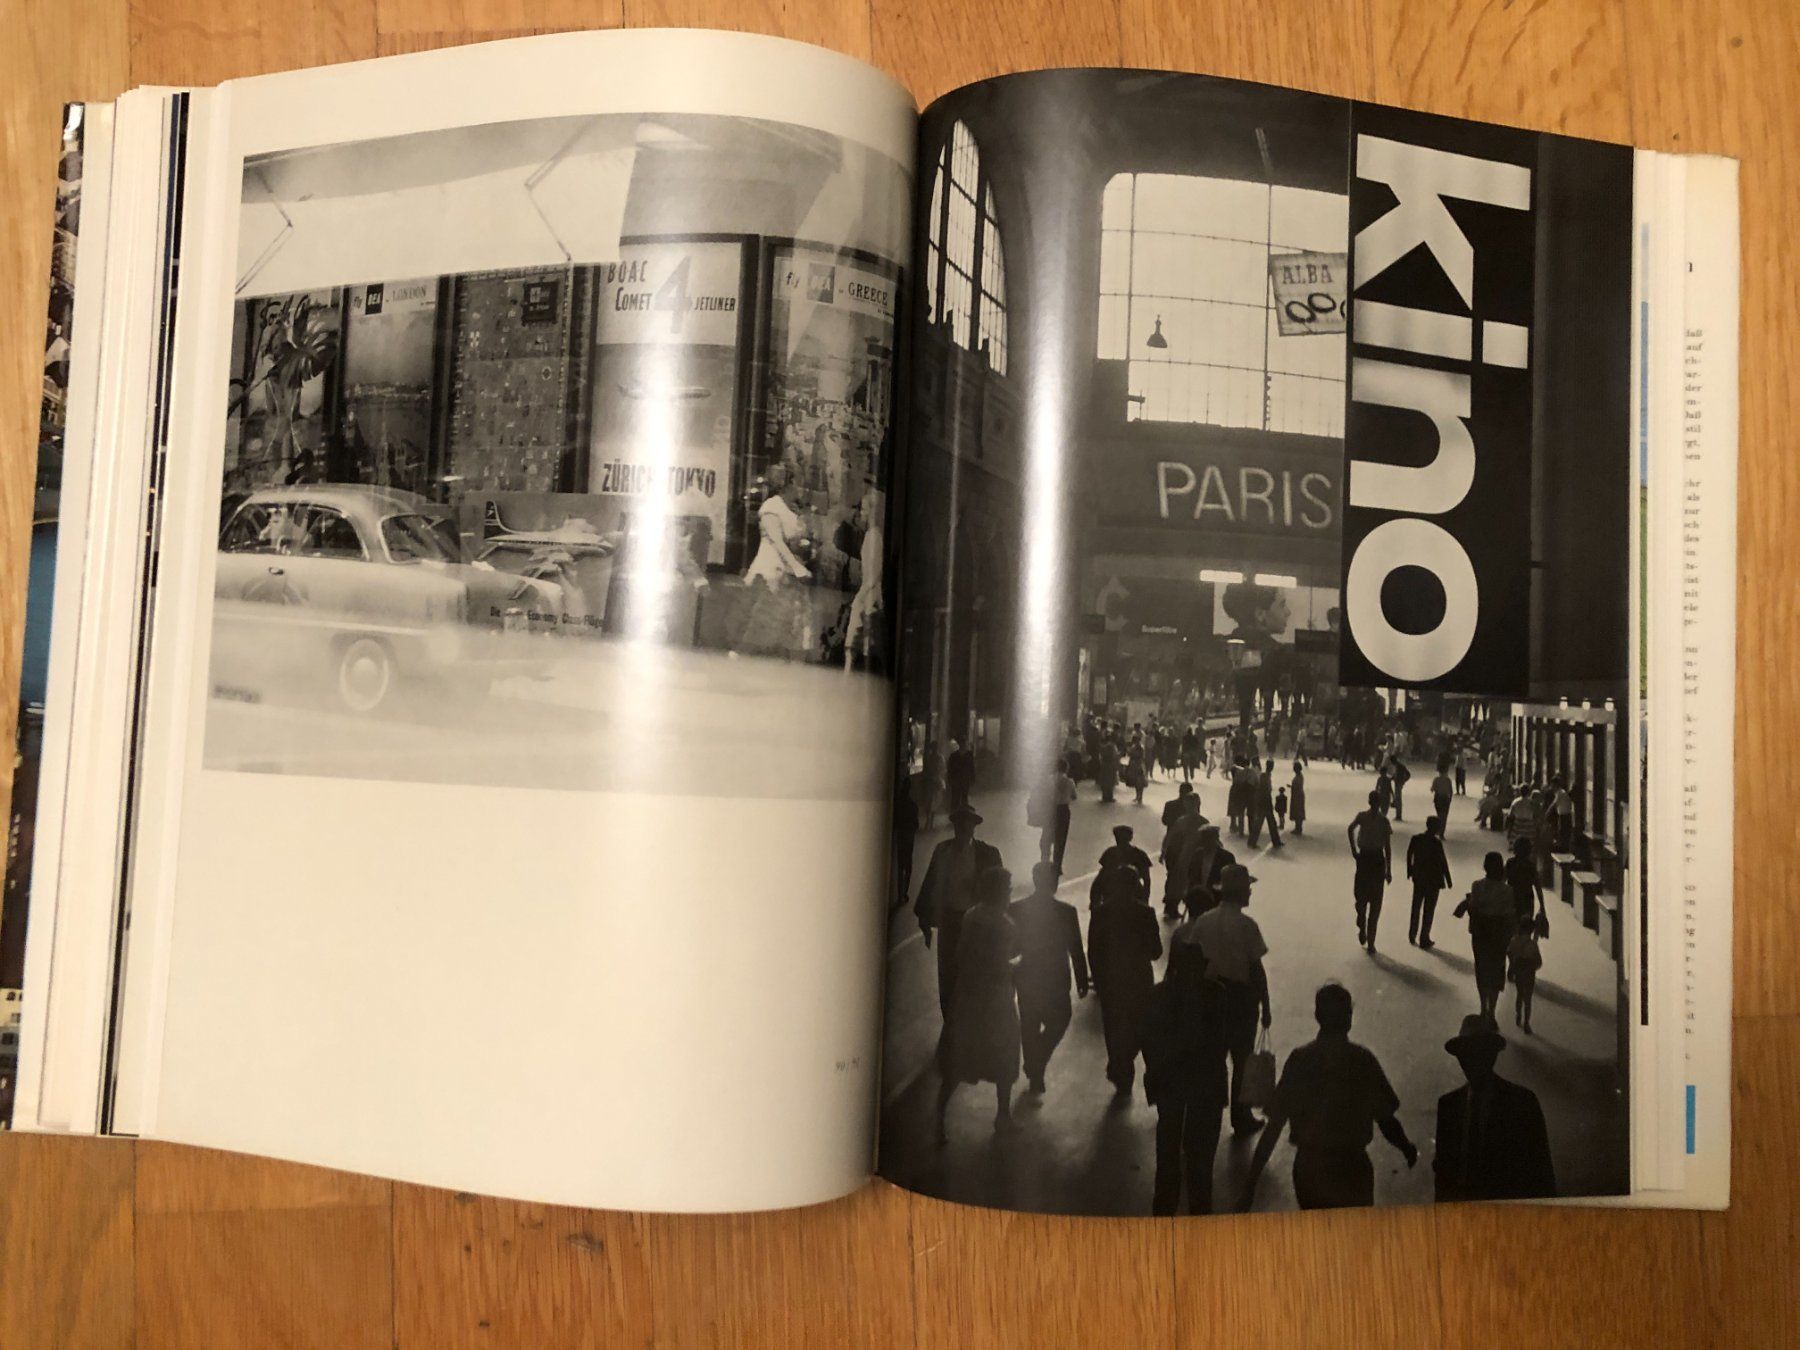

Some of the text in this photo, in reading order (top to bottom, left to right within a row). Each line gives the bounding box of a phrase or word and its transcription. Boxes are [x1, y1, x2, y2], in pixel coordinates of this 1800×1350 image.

[607, 260, 648, 283] BOAC
[615, 256, 736, 334] COMET 4 JETLINER
[848, 281, 888, 307] GREECE
[1346, 133, 1531, 682] kino
[668, 466, 716, 498] TOKYO
[1157, 461, 1332, 529] PARIS
